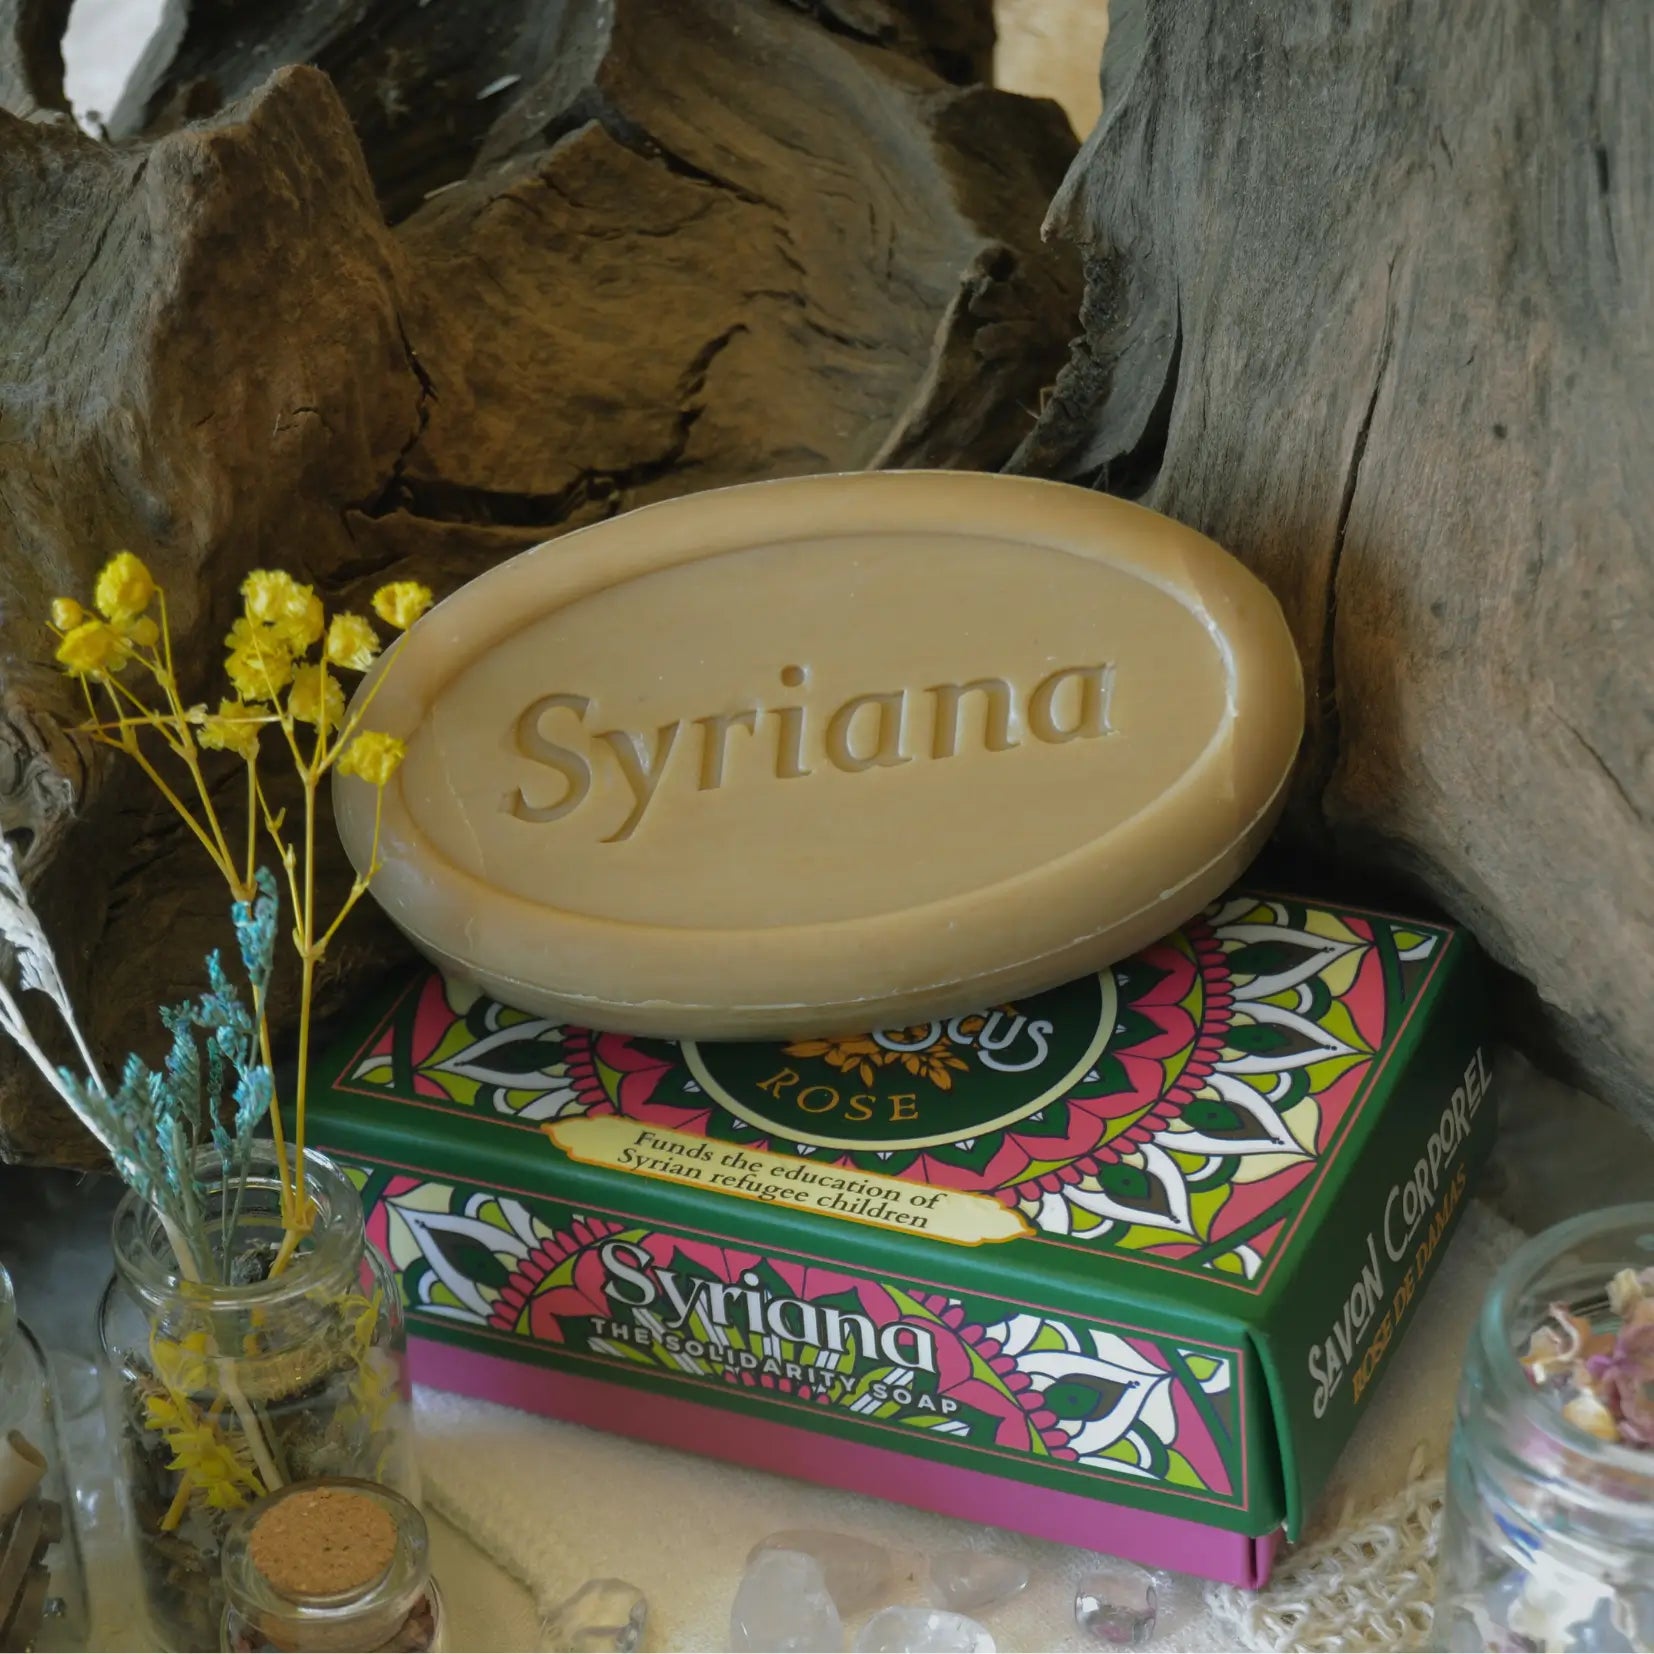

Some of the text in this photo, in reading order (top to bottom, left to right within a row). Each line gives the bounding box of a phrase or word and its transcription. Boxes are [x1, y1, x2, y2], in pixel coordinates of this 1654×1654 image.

[503, 661, 1118, 843] Syriana
[756, 1067, 919, 1122] ROSE
[617, 1146, 928, 1228] Syrian refugee children
[635, 1131, 949, 1210] Funds the education of
[1308, 1046, 1493, 1420] SAVON CORPOREL
[1351, 1162, 1467, 1405] ROSE DE DAMAS
[600, 1240, 937, 1374] Syriana
[589, 1317, 959, 1415] THE SOLIDARITY SOAP
